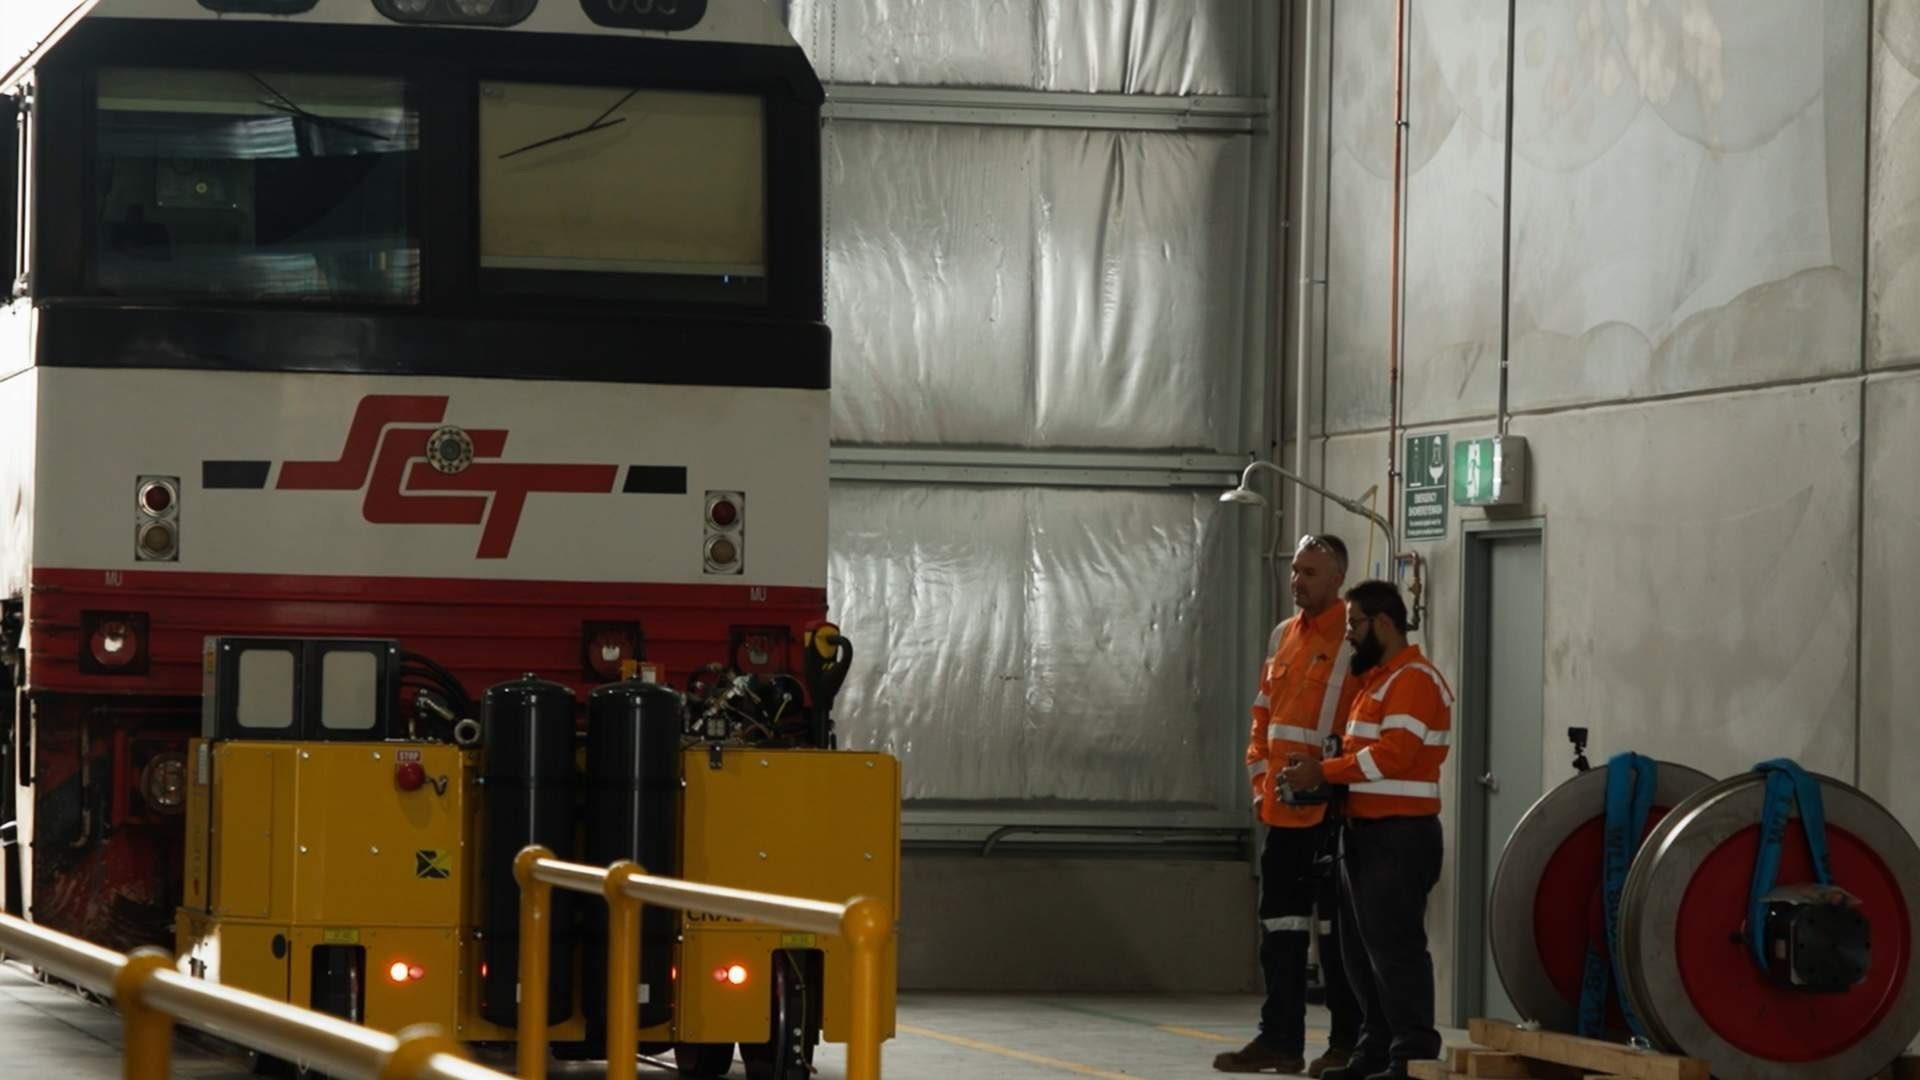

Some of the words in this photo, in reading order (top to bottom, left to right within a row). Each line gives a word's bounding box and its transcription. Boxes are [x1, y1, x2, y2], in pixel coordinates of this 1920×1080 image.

[275, 394, 619, 559] SCT
[105, 570, 123, 587] MU
[750, 587, 768, 602] MU
[399, 751, 419, 761] STOP
